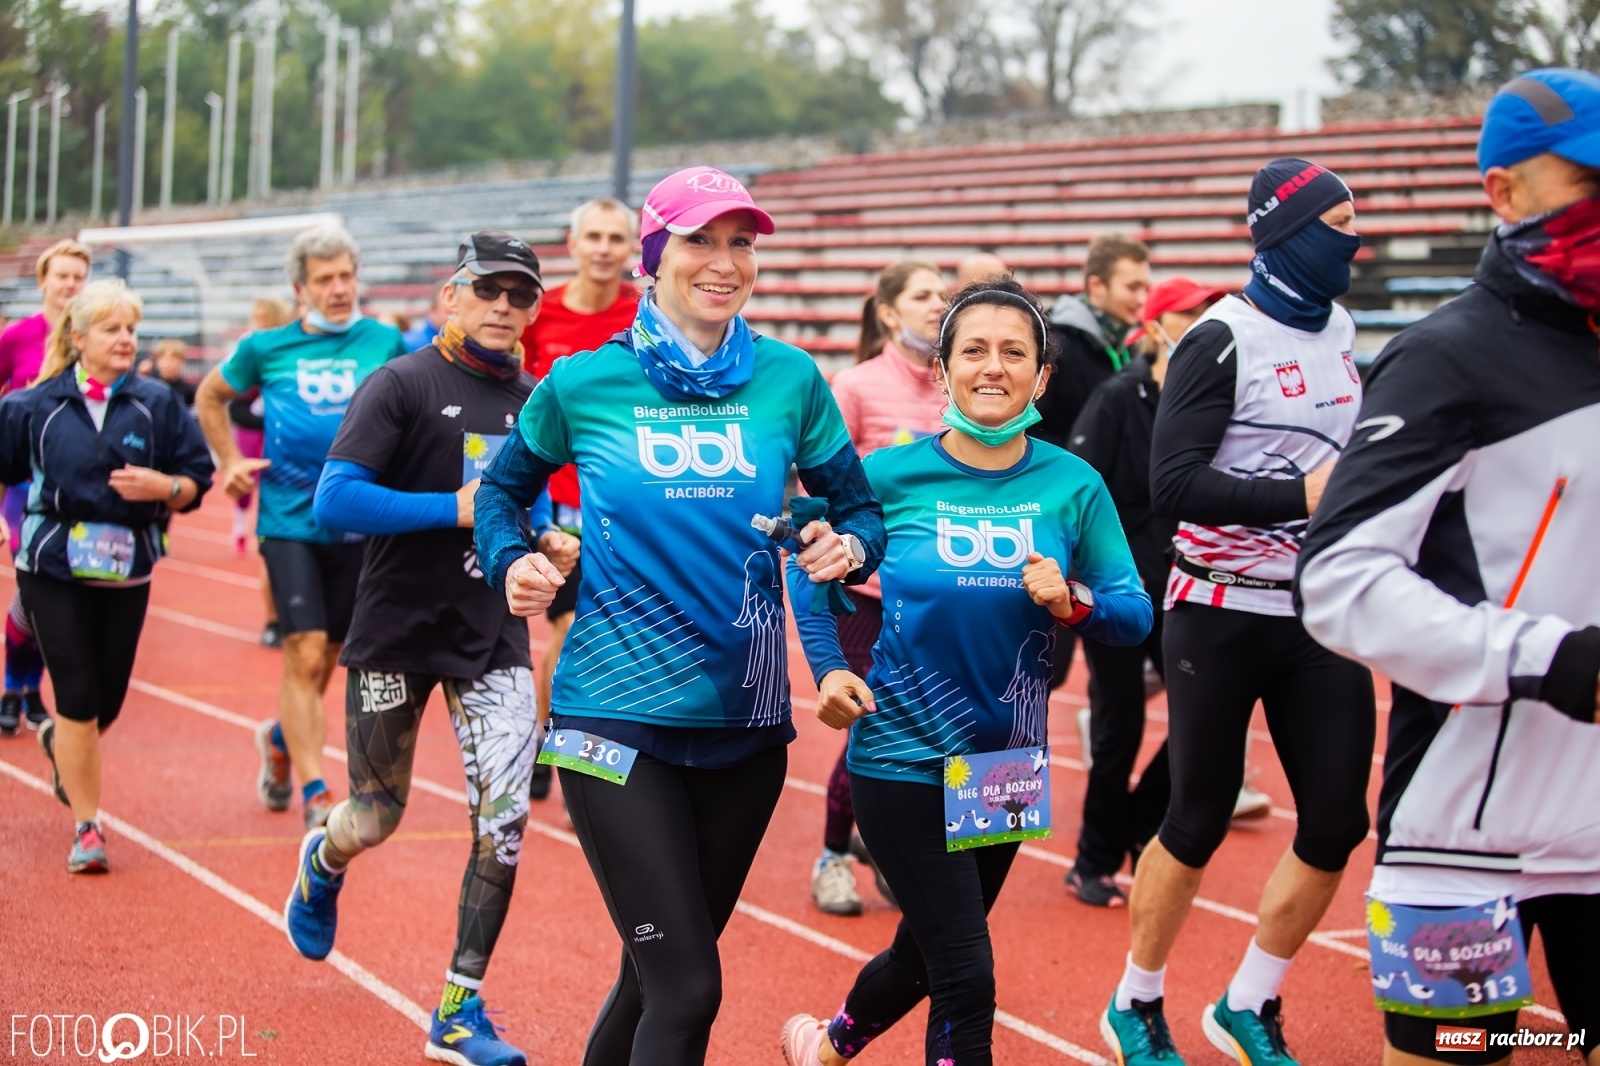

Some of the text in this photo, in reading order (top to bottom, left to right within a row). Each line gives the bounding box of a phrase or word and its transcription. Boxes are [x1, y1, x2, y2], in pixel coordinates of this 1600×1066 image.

[441, 405, 463, 418] 4F
[634, 403, 749, 420] BiegamBoLubię
[636, 423, 757, 478] bbl
[665, 485, 735, 499] RACIBÓRZ
[937, 501, 1041, 515] BiegamBoLubię
[937, 518, 1036, 569] bbl
[1237, 577, 1277, 589] Kalenji
[578, 740, 621, 766] 230
[958, 788, 978, 800] BIEG
[983, 785, 1001, 797] DLA
[1006, 810, 1040, 828] 014
[634, 931, 664, 942] Kalenji
[1414, 947, 1442, 962] DLA
[1465, 975, 1517, 1003] 313
